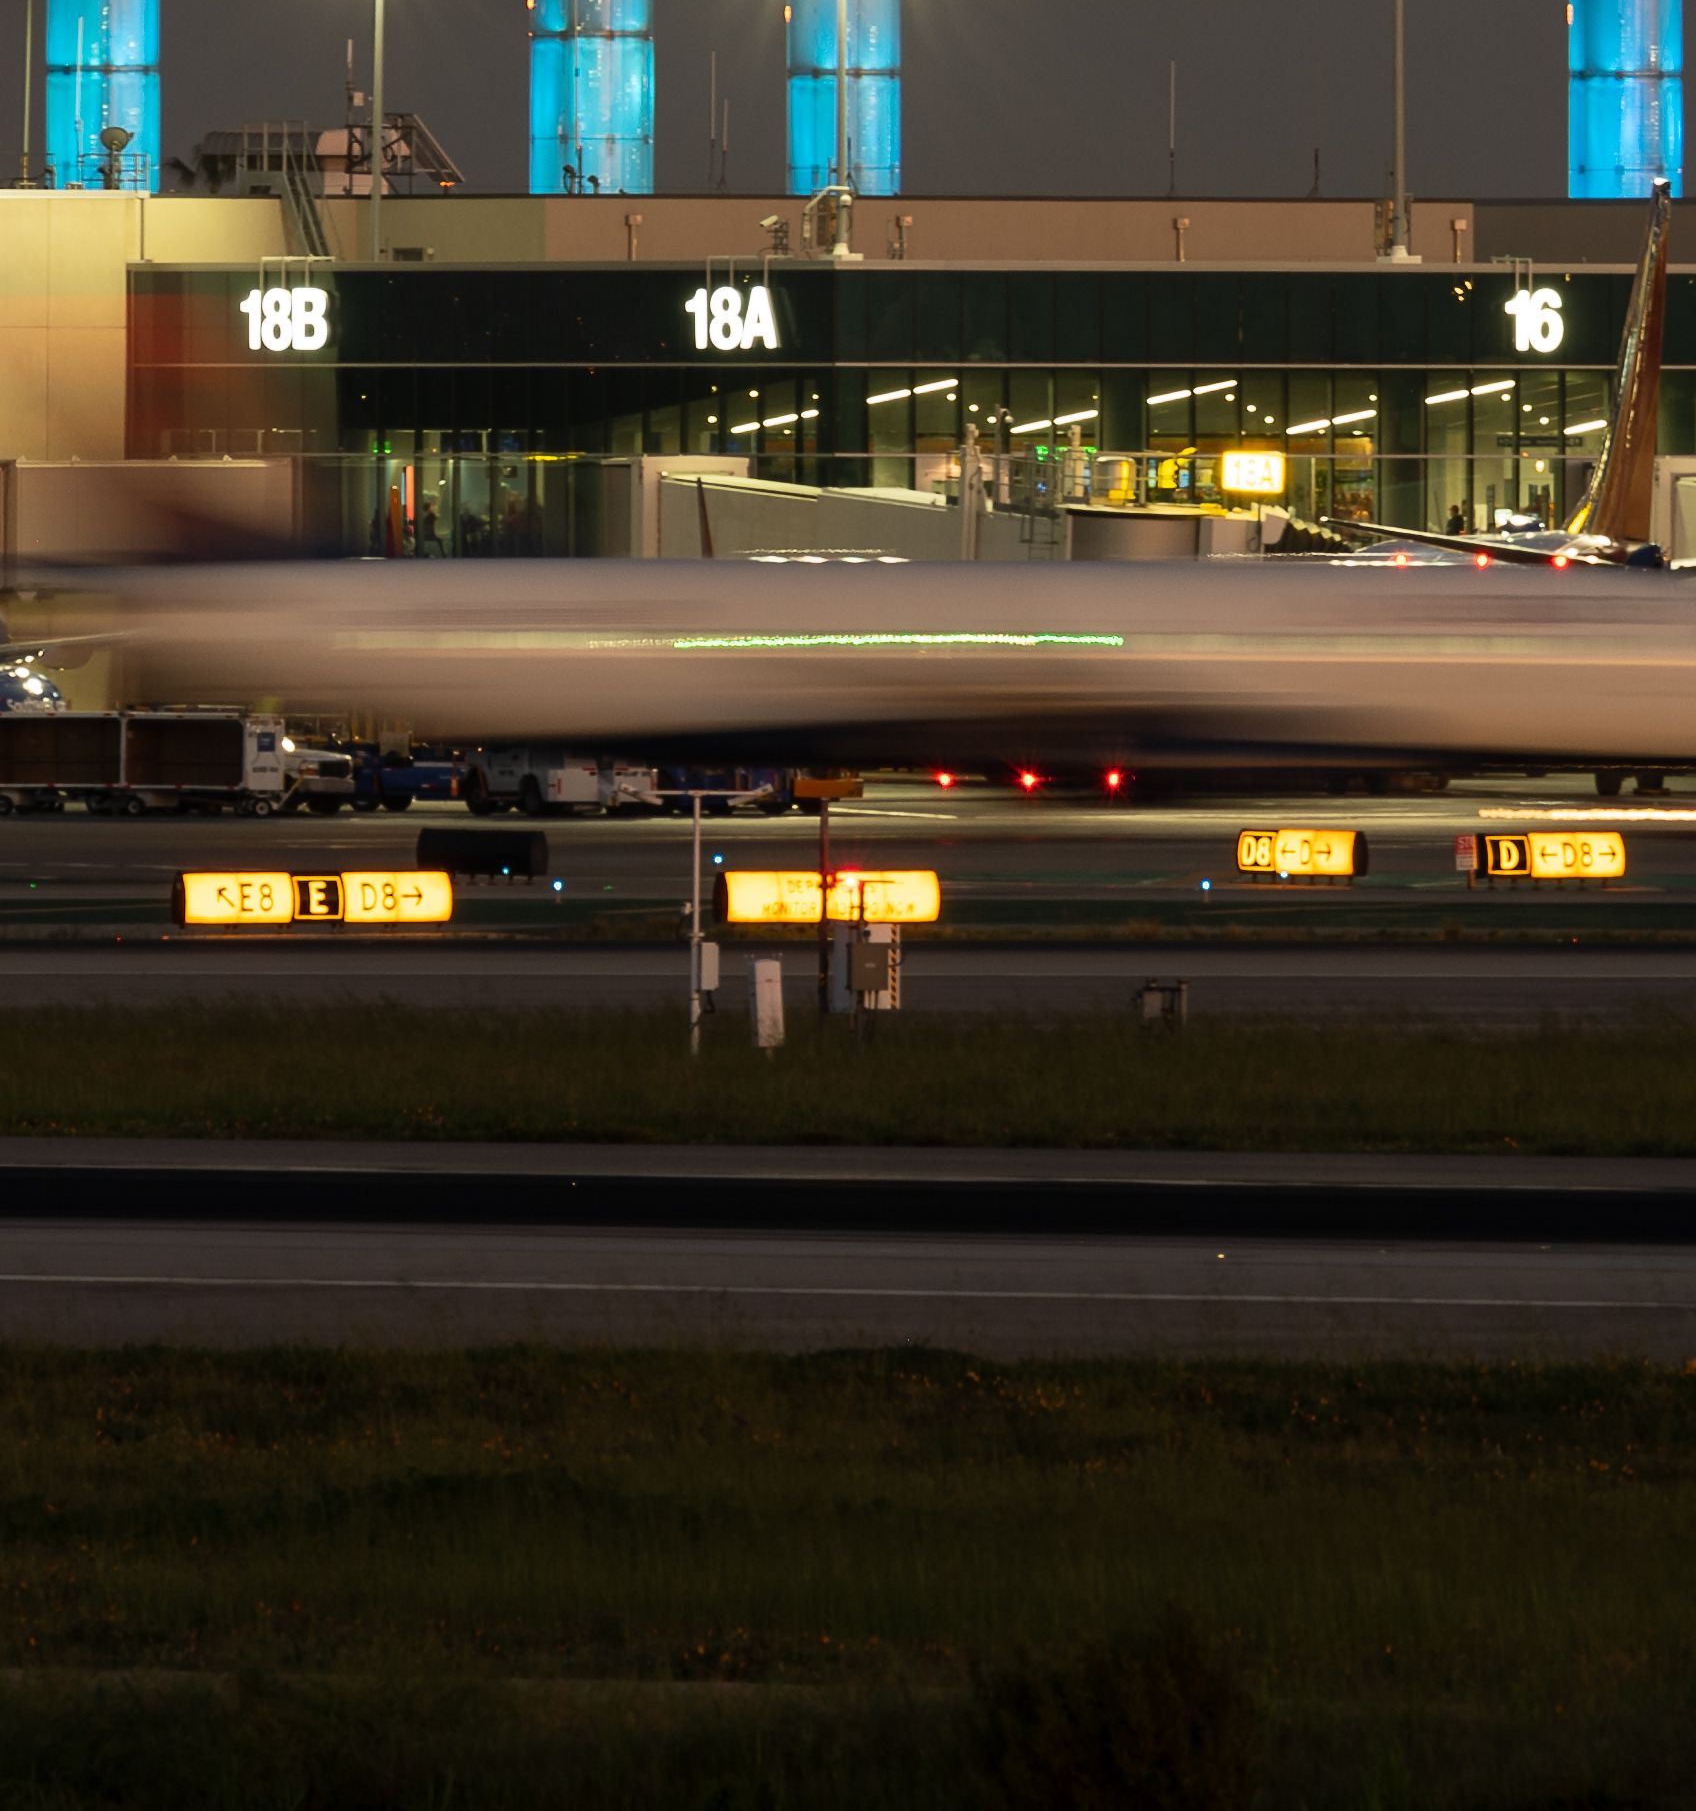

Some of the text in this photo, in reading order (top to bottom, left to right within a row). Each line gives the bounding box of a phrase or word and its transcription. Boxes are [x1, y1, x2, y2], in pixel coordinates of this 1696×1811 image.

[240, 287, 328, 351] 18B
[685, 286, 778, 351] 18A
[1505, 288, 1564, 353] 16
[1241, 835, 1272, 866] D8
[1300, 840, 1311, 865] D
[1499, 840, 1520, 870] D
[1562, 842, 1593, 868] D8
[239, 883, 274, 912] E8
[308, 880, 330, 915] E
[361, 883, 398, 911] D8
